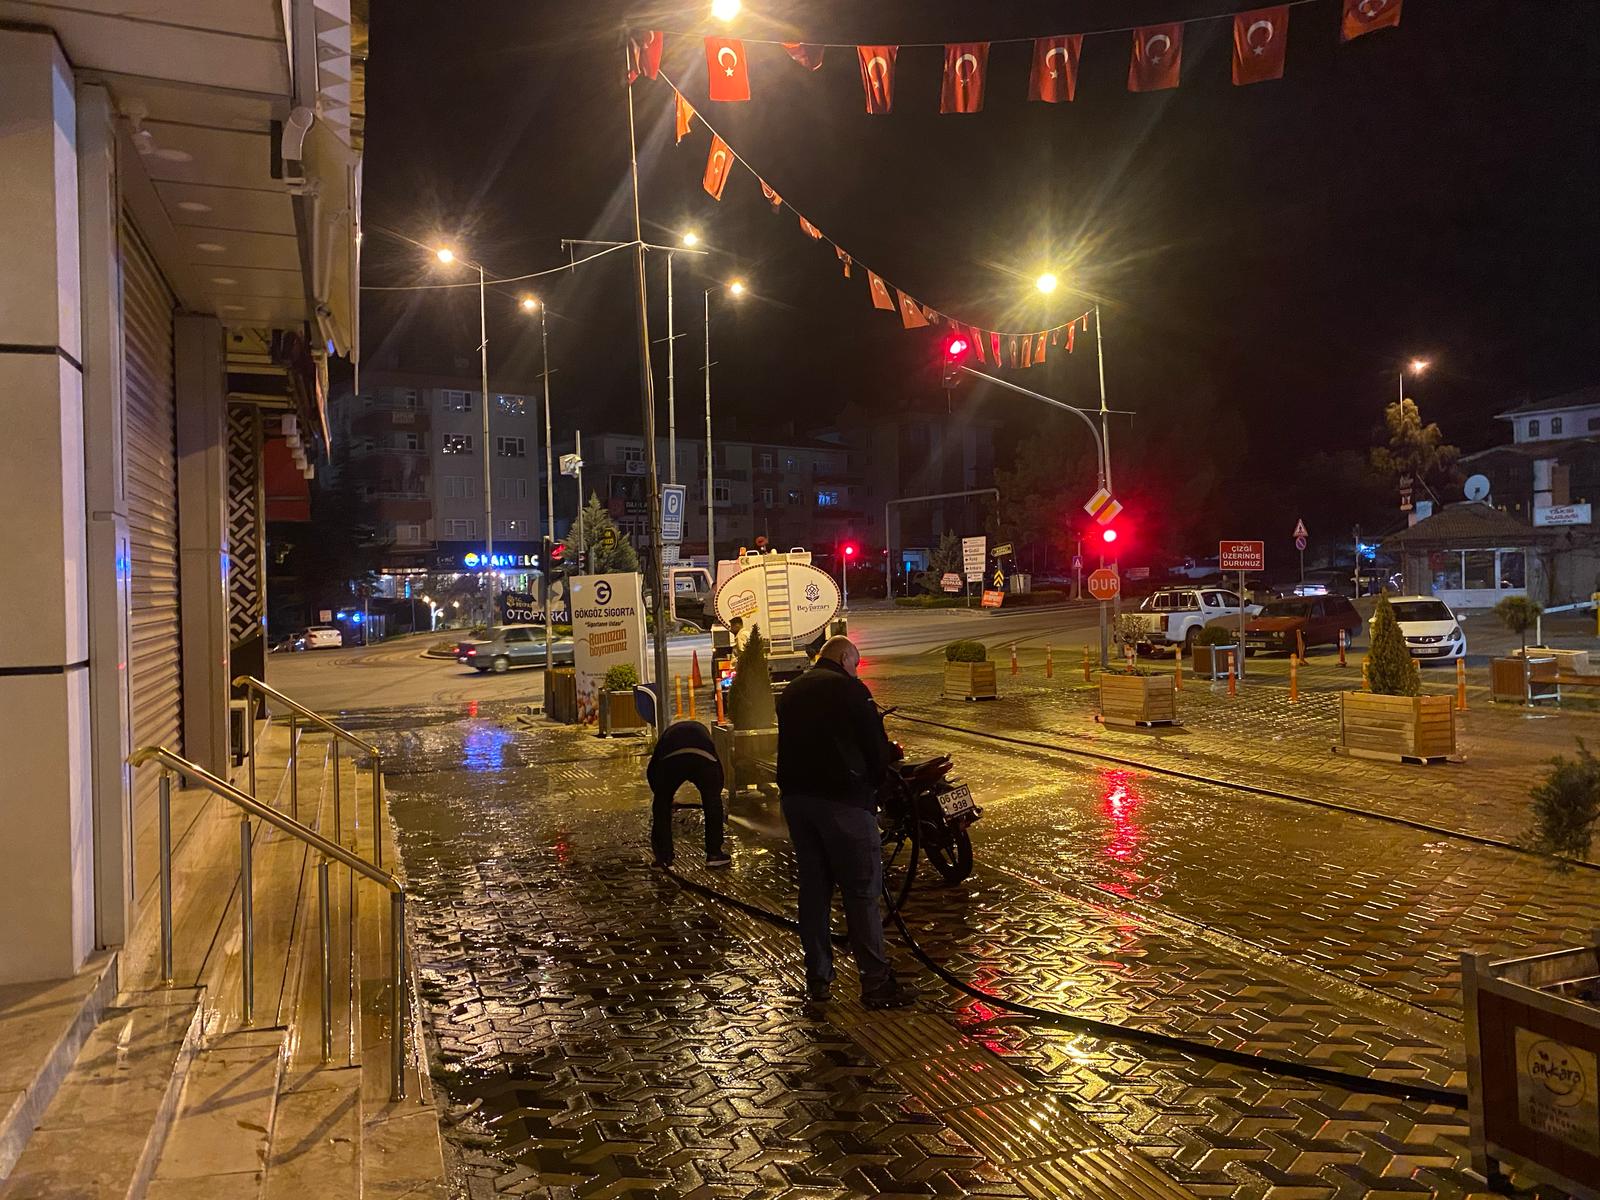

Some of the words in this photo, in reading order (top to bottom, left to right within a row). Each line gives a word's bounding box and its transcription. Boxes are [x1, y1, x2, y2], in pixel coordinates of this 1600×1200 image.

[1231, 545, 1252, 553] ÇİZGİ
[1222, 552, 1261, 560] ÜZERİNDE
[1091, 578, 1118, 591] DUR
[506, 609, 568, 622] OTOPARKI
[574, 608, 603, 619] GÖKGÖZ
[604, 607, 635, 618] SİGORTA
[589, 628, 627, 646] Ramazan
[939, 794, 951, 805] 06
[951, 787, 969, 801] CED
[952, 799, 968, 811] 938
[1532, 1061, 1581, 1084] ankara
